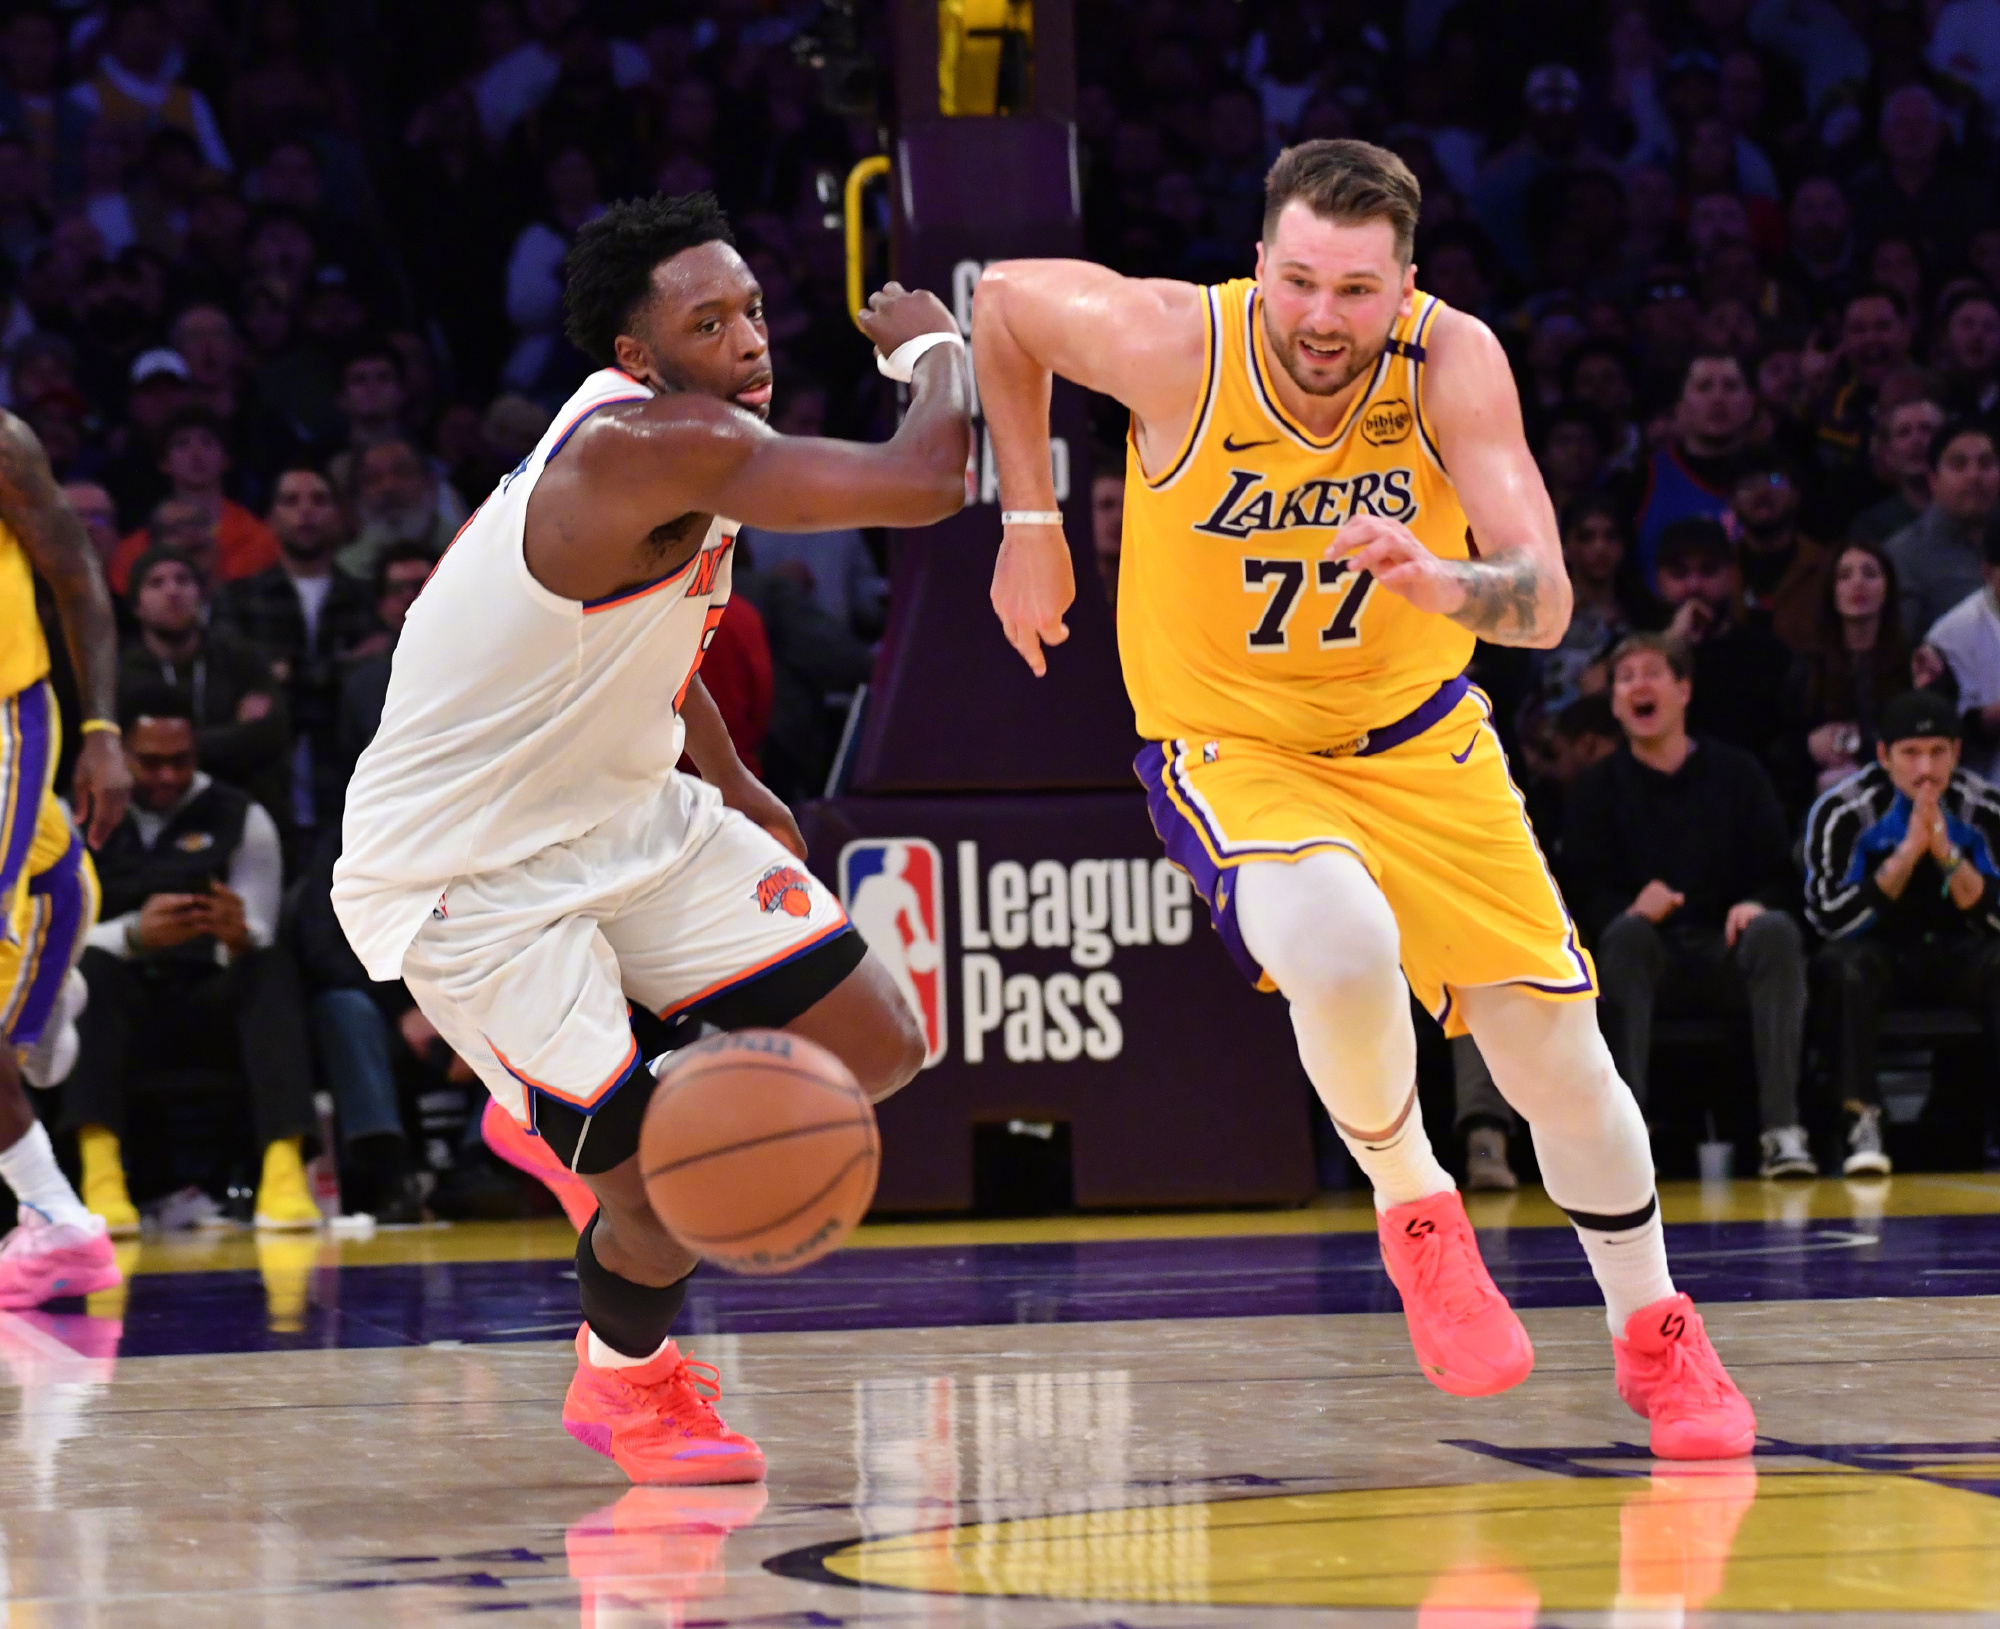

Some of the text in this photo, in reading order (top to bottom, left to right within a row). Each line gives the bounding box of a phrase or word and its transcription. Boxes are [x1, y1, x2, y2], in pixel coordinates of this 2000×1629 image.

[1191, 468, 1420, 541] LAKERS
[1241, 556, 1379, 653] 77
[957, 840, 1193, 968] League
[961, 952, 1124, 1064] Pass
